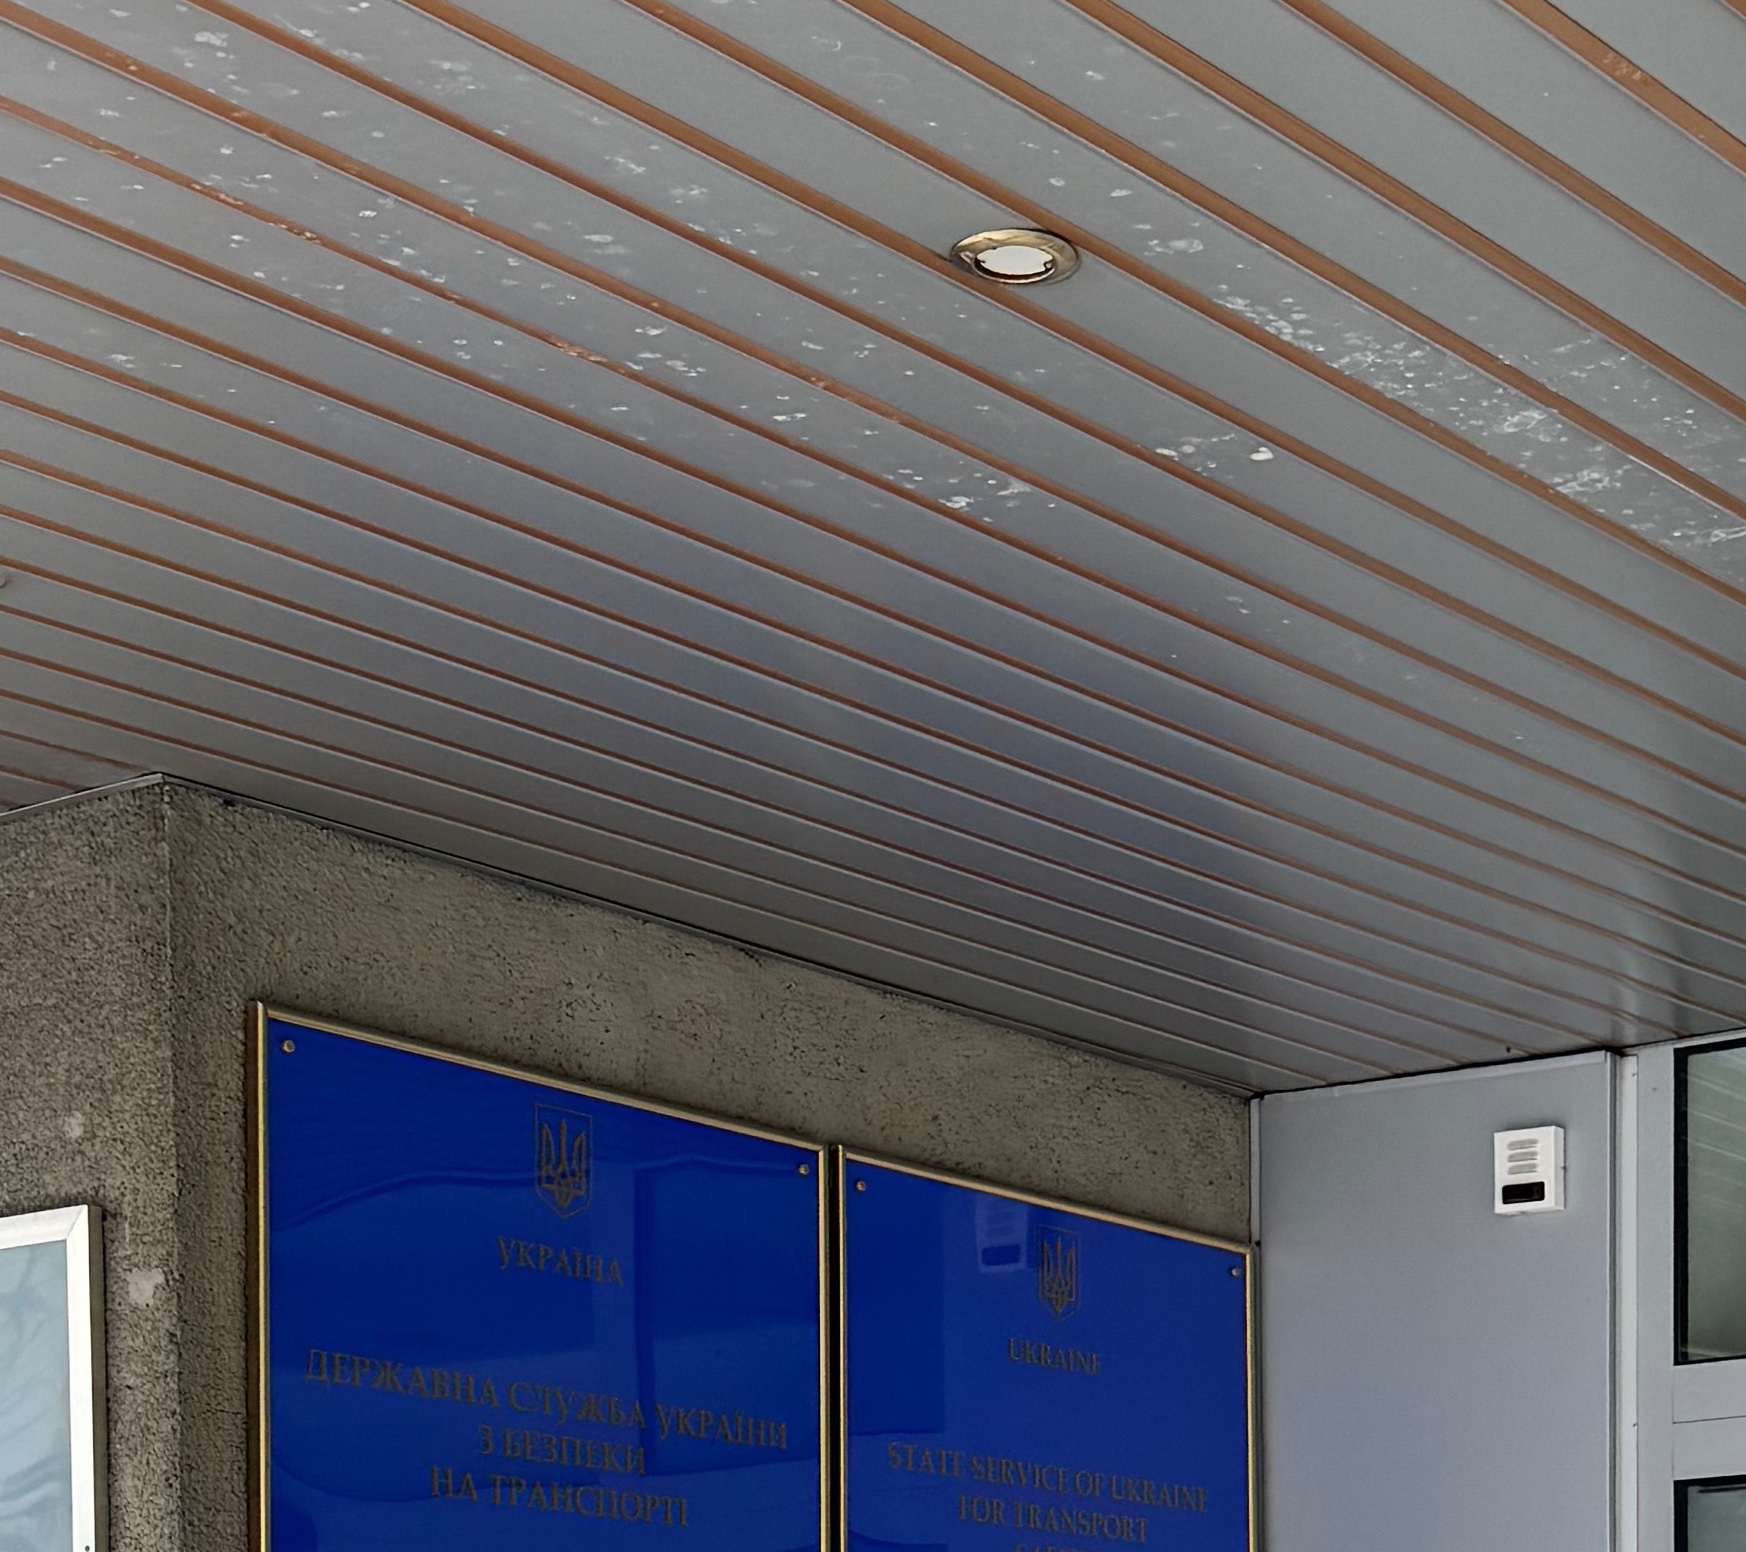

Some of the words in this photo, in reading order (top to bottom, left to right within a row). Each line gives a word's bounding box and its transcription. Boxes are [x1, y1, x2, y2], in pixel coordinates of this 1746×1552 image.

[497, 1233, 624, 1286] УКРАЇНА
[1006, 1336, 1102, 1376] UKRAINE
[304, 1348, 499, 1409] ДЕРЖАВНА
[508, 1380, 646, 1430] СЛУЖБА
[656, 1402, 788, 1450] УКРАЇНИ
[478, 1423, 494, 1456] З
[503, 1427, 646, 1477] БЕЗПЕКИ
[887, 1440, 964, 1478] STATE
[969, 1455, 1071, 1494] SERVICE
[1073, 1468, 1105, 1498] OF
[1109, 1474, 1209, 1514] UKRAINE
[430, 1465, 480, 1506] НА
[488, 1473, 689, 1528] ТРАНСПОРТІ
[957, 1494, 1006, 1526] FOR
[1012, 1500, 1150, 1544] TRANSPORT
